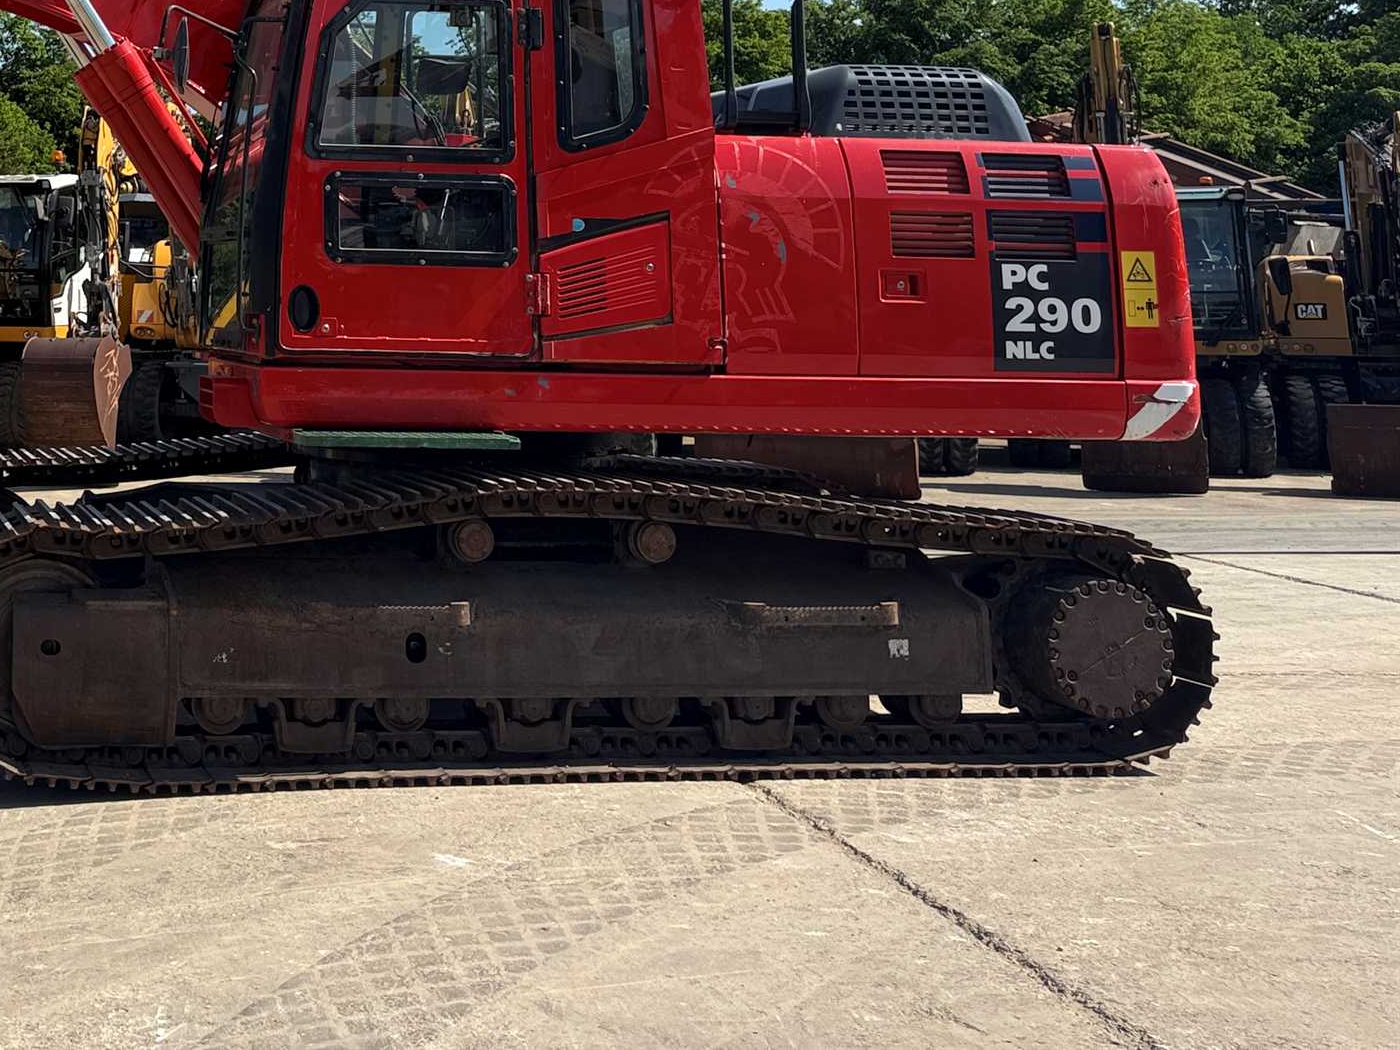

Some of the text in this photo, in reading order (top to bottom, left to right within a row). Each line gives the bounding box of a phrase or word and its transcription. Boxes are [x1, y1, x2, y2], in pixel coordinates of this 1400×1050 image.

[1001, 263, 1049, 291] PC
[1004, 296, 1102, 334] 290
[1296, 303, 1324, 319] CAT
[1005, 340, 1056, 360] NLC
